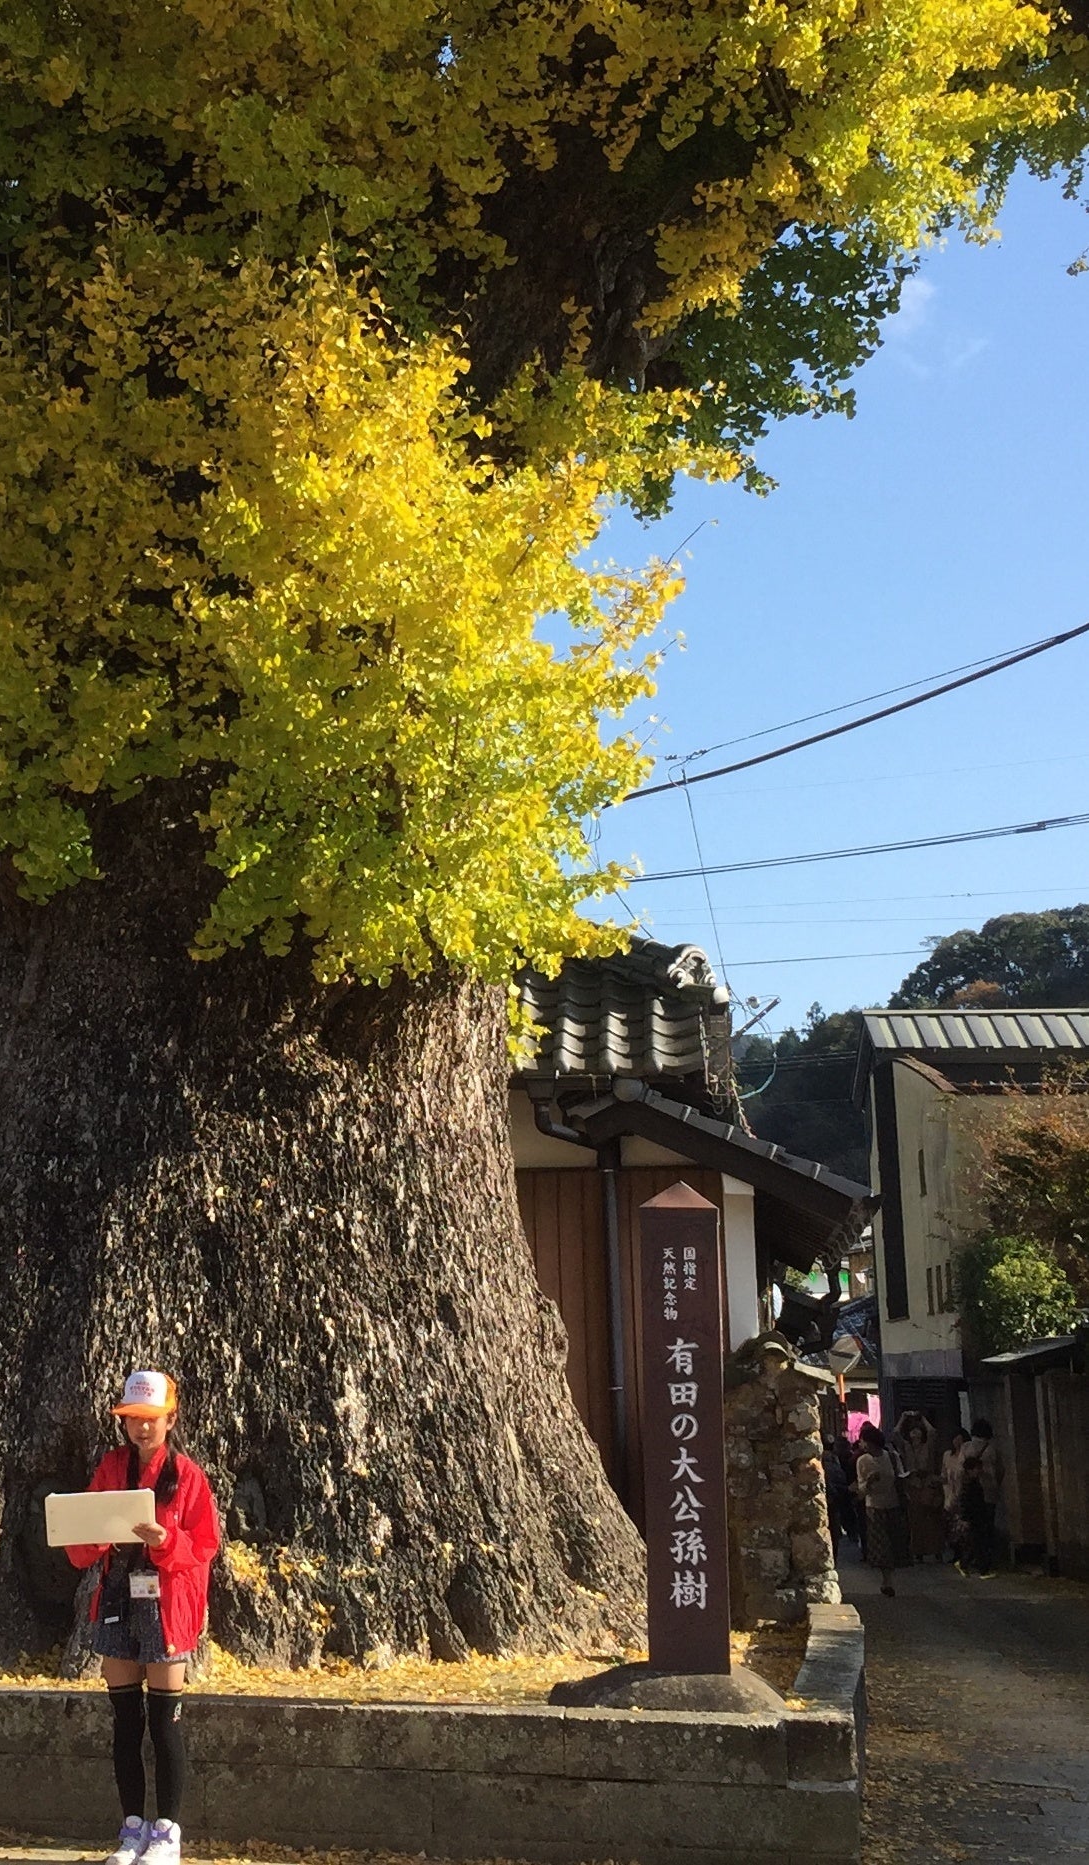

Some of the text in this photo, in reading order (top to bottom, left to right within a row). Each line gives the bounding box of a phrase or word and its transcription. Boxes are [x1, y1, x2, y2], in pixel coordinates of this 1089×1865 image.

[662, 1246, 678, 1320] 天然記念物
[683, 1246, 697, 1290] 国指定
[666, 1337, 708, 1610] 有田の大公孫樹
